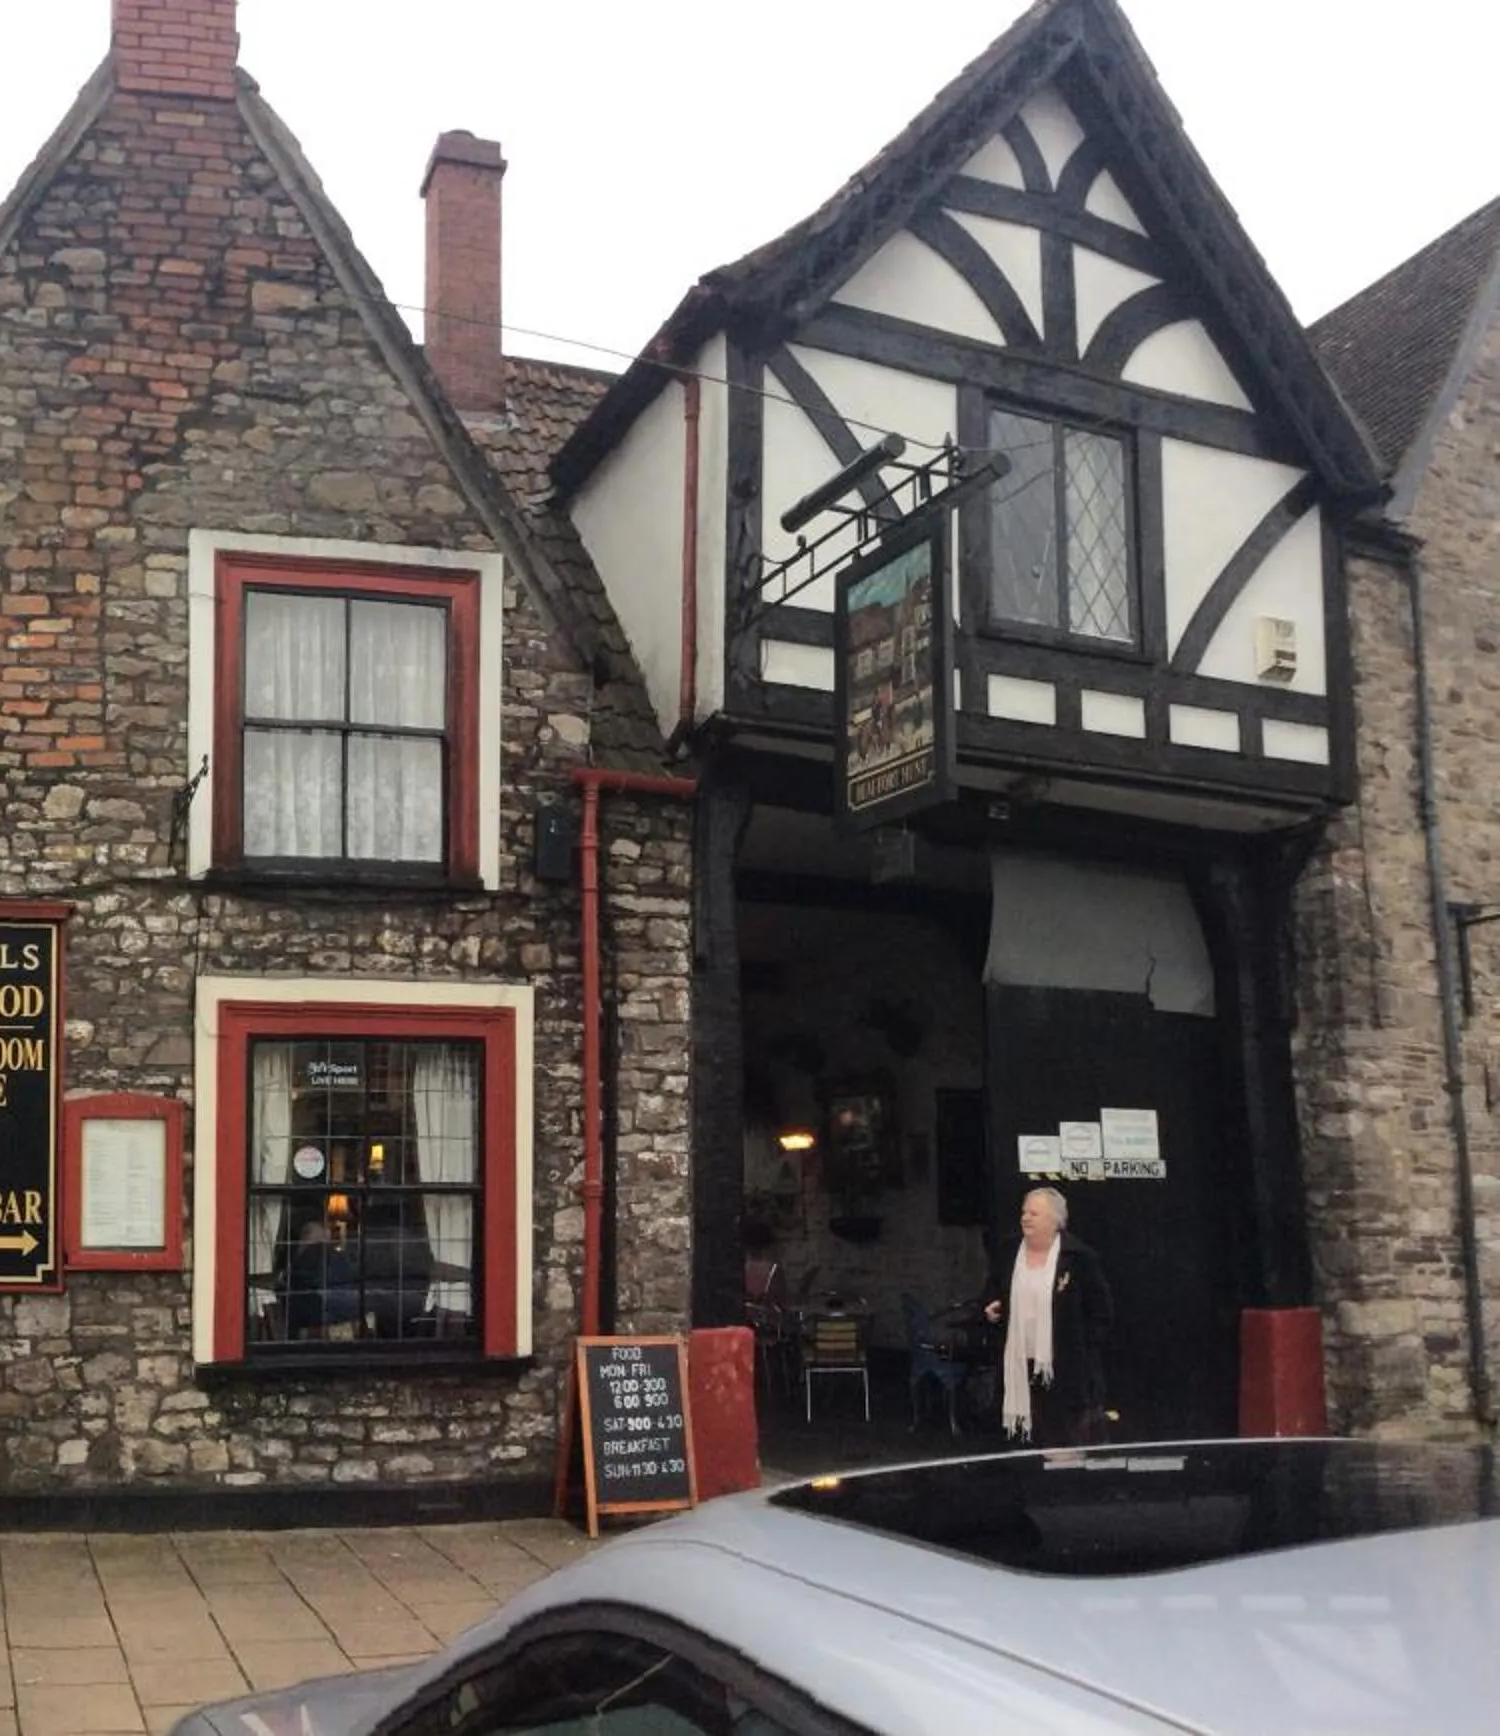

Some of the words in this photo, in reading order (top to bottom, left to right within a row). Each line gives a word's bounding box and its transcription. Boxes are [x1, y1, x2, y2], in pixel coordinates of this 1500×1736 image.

[1070, 1161, 1089, 1175] NO
[1103, 1160, 1160, 1176] PARKING
[611, 1347, 642, 1361] FOOD
[599, 1363, 626, 1379] MON
[631, 1363, 651, 1377] FRI
[603, 1436, 671, 1456] BREAKFAST
